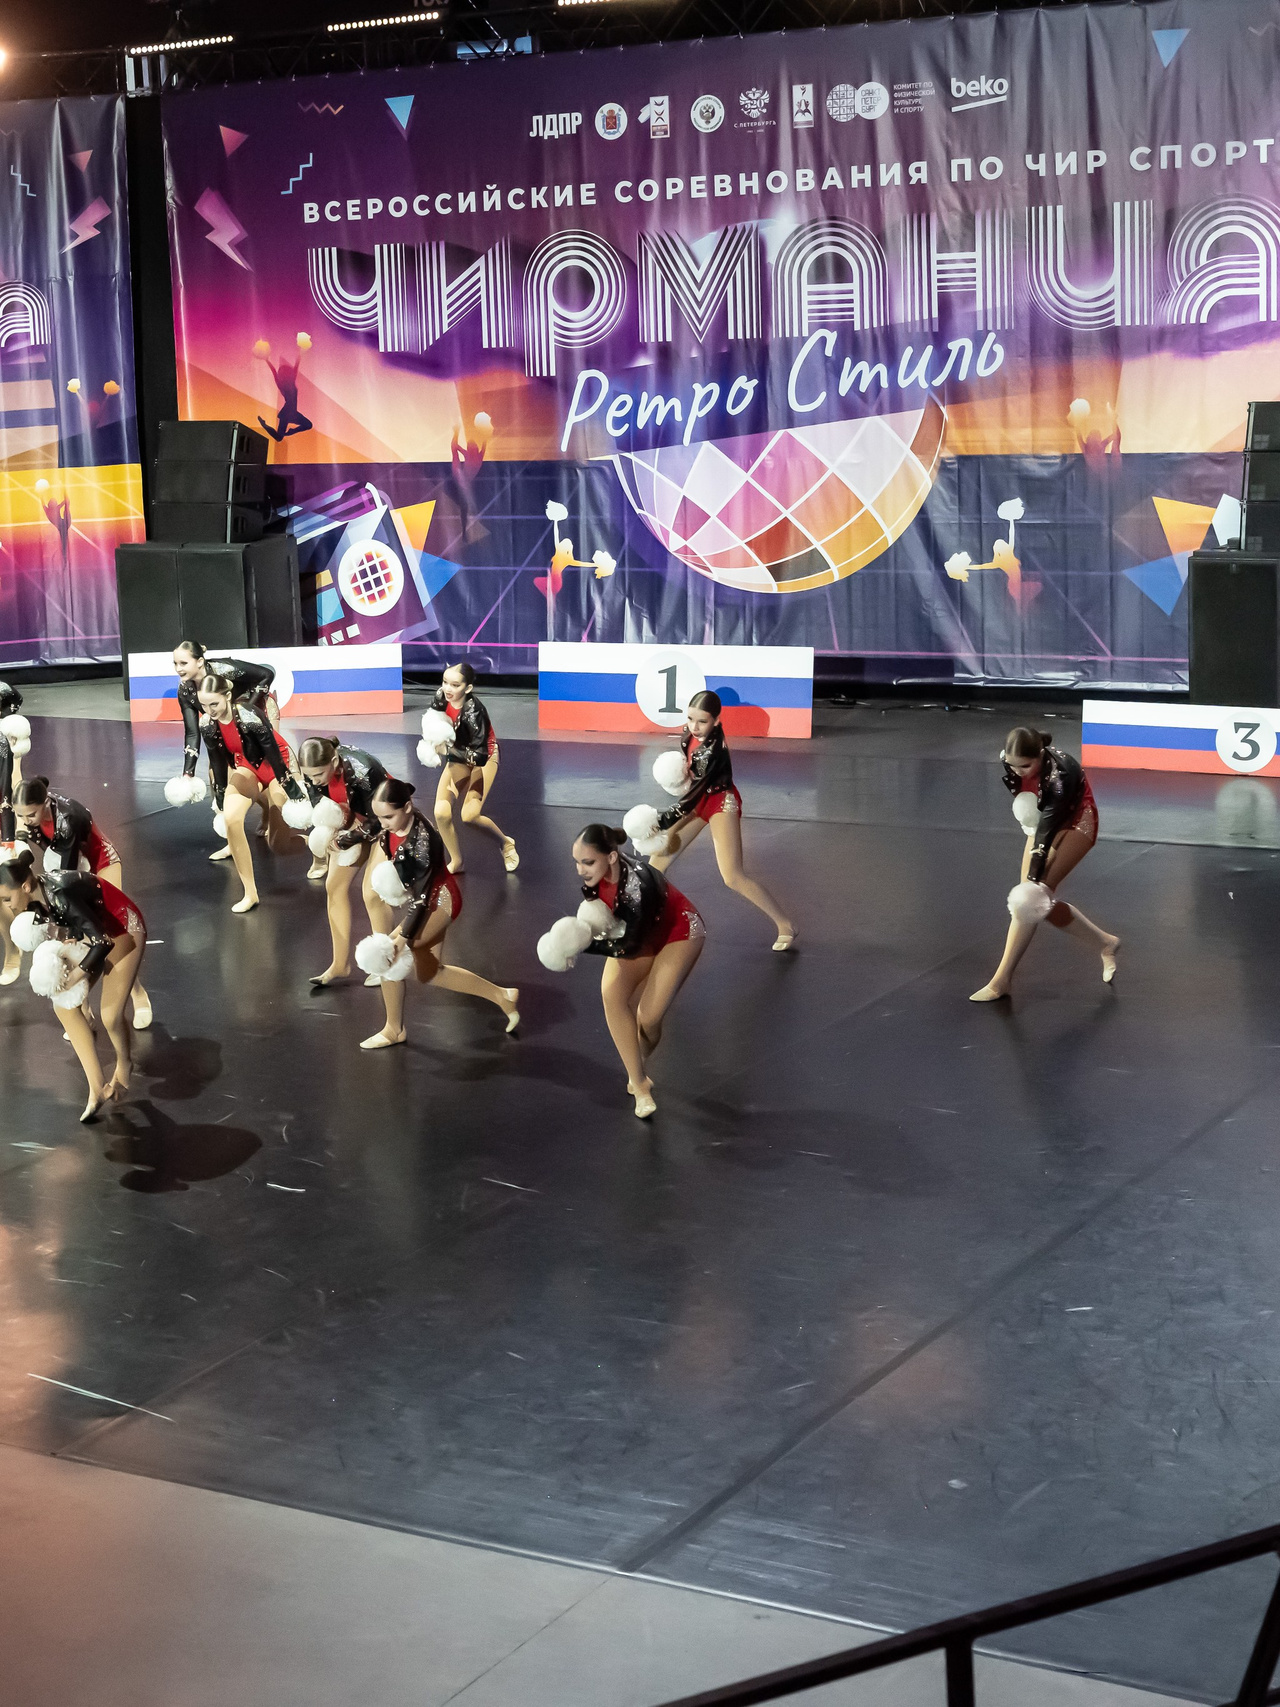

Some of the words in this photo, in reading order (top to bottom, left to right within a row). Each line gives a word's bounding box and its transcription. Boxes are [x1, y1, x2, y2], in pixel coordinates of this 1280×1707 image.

[950, 75, 1009, 98] beko
[529, 112, 583, 140] ЛДПР
[303, 183, 597, 224] ВСЕРОССИЙСКИЕ
[614, 161, 928, 203] СОРЕВНОВАНИЯ
[951, 156, 1004, 182] ПО
[1025, 150, 1107, 177] ЧИР
[1129, 138, 1275, 171] СПОРТ
[560, 368, 758, 452] Ретро
[787, 328, 1004, 413] Стиль
[658, 665, 683, 713] 1
[1232, 722, 1260, 761] 3
